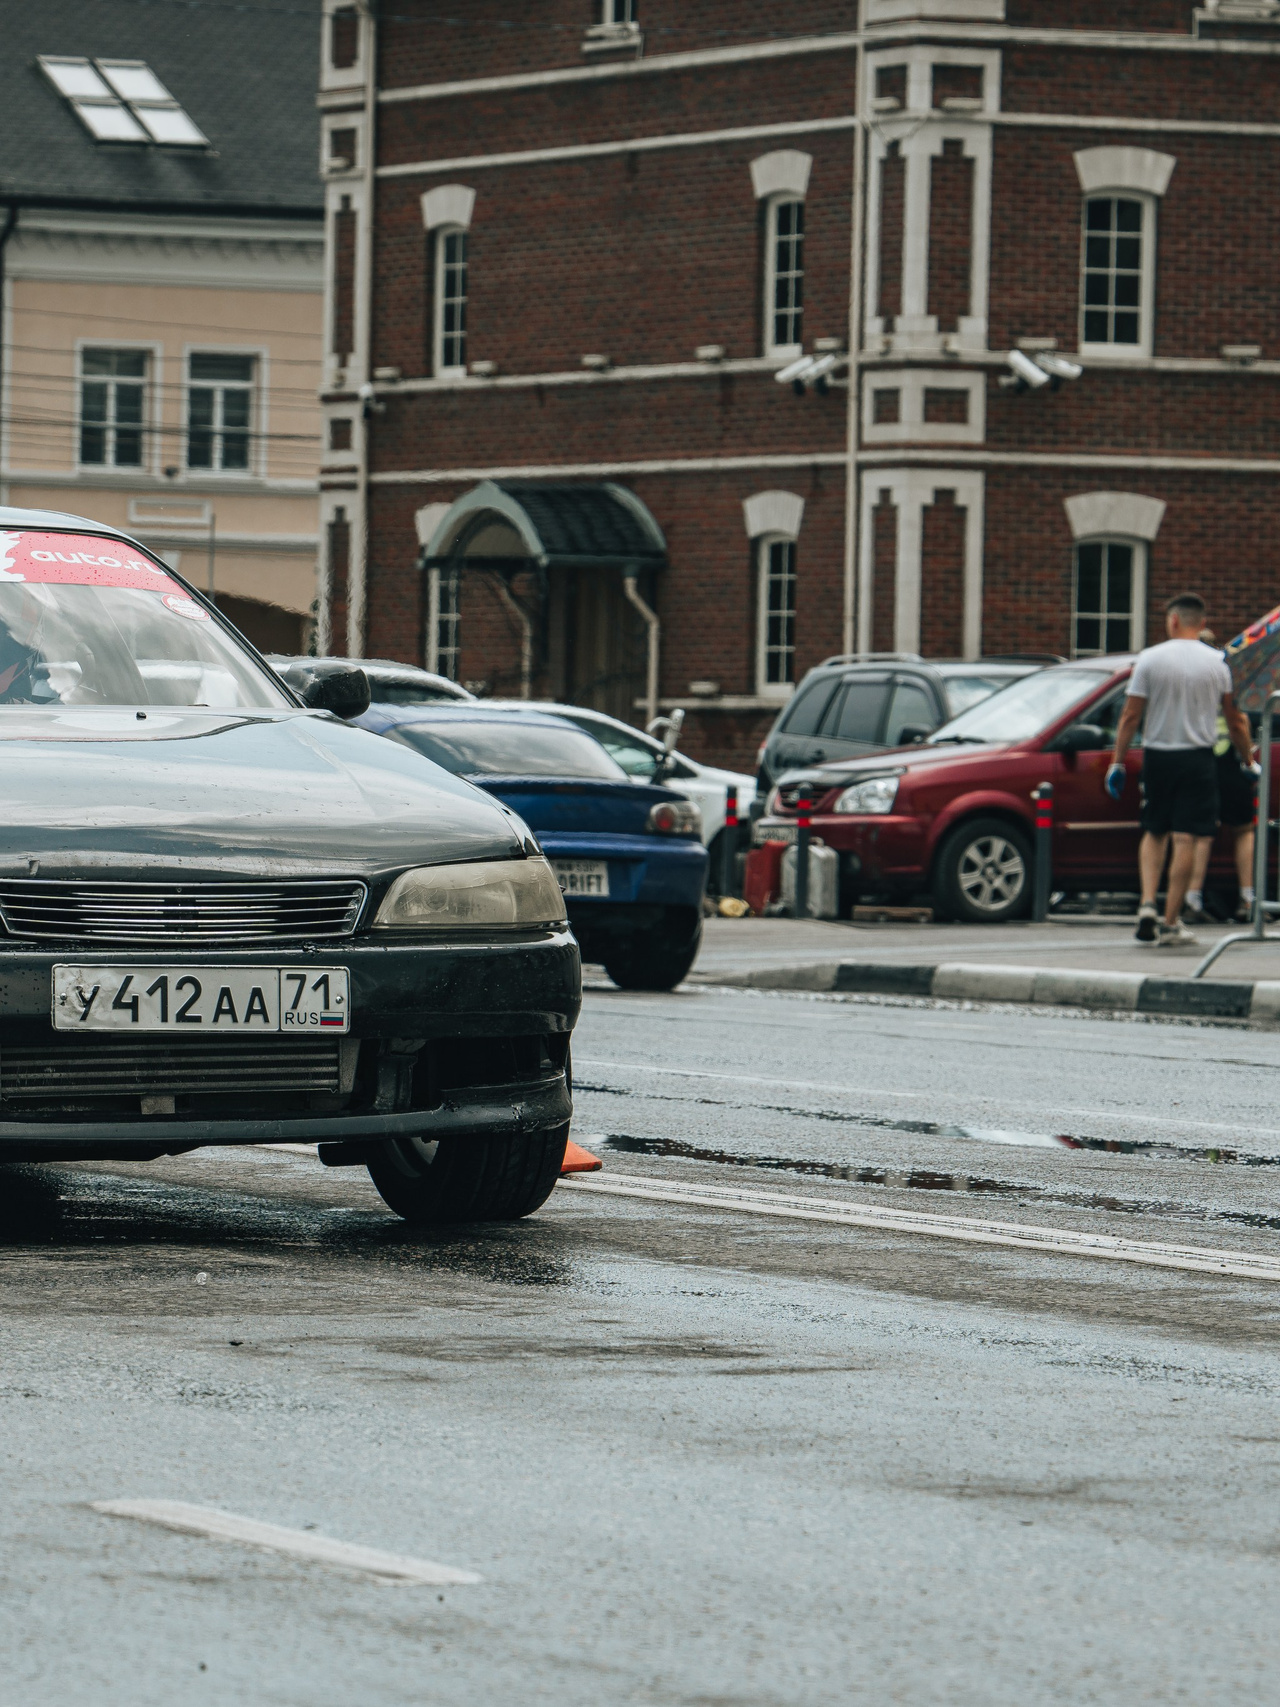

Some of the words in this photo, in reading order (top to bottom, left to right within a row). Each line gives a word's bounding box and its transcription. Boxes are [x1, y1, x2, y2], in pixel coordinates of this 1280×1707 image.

[30, 550, 167, 576] auto.ru
[285, 974, 330, 1010] 71
[285, 1012, 319, 1025] RUS
